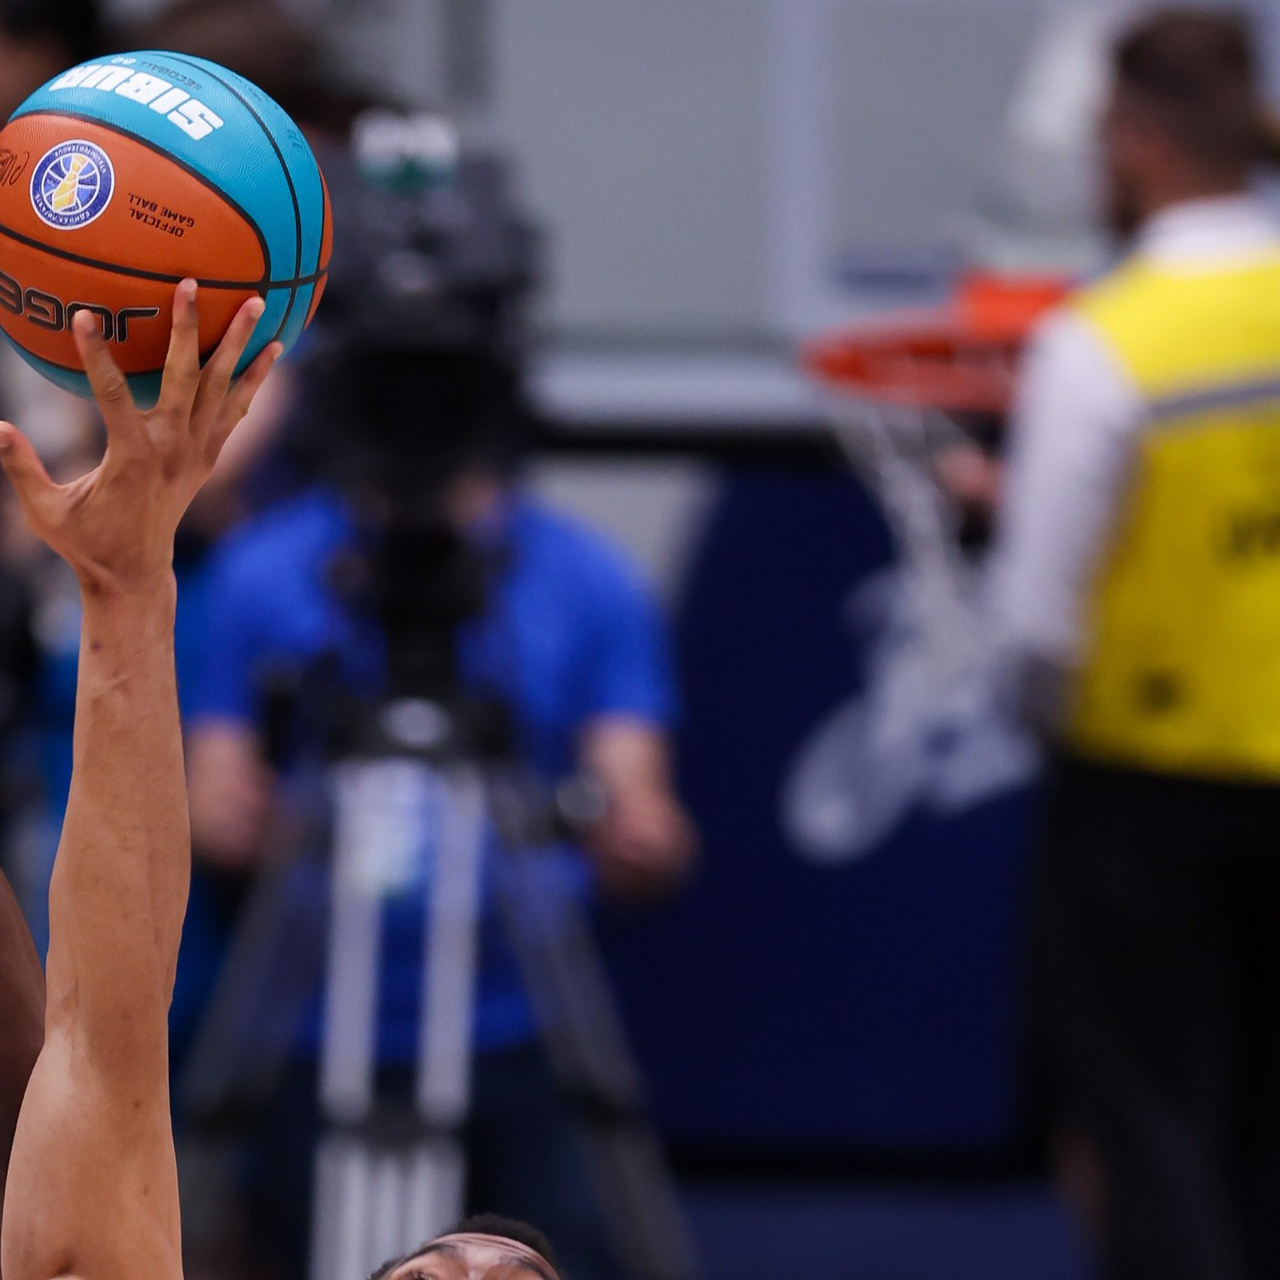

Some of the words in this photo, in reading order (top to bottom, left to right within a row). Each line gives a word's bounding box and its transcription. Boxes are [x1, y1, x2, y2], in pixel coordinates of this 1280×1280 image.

[49, 64, 224, 141] SIBUR
[128, 192, 158, 213] BALL
[129, 207, 184, 238] OFFICIAL
[160, 206, 195, 228] GAME
